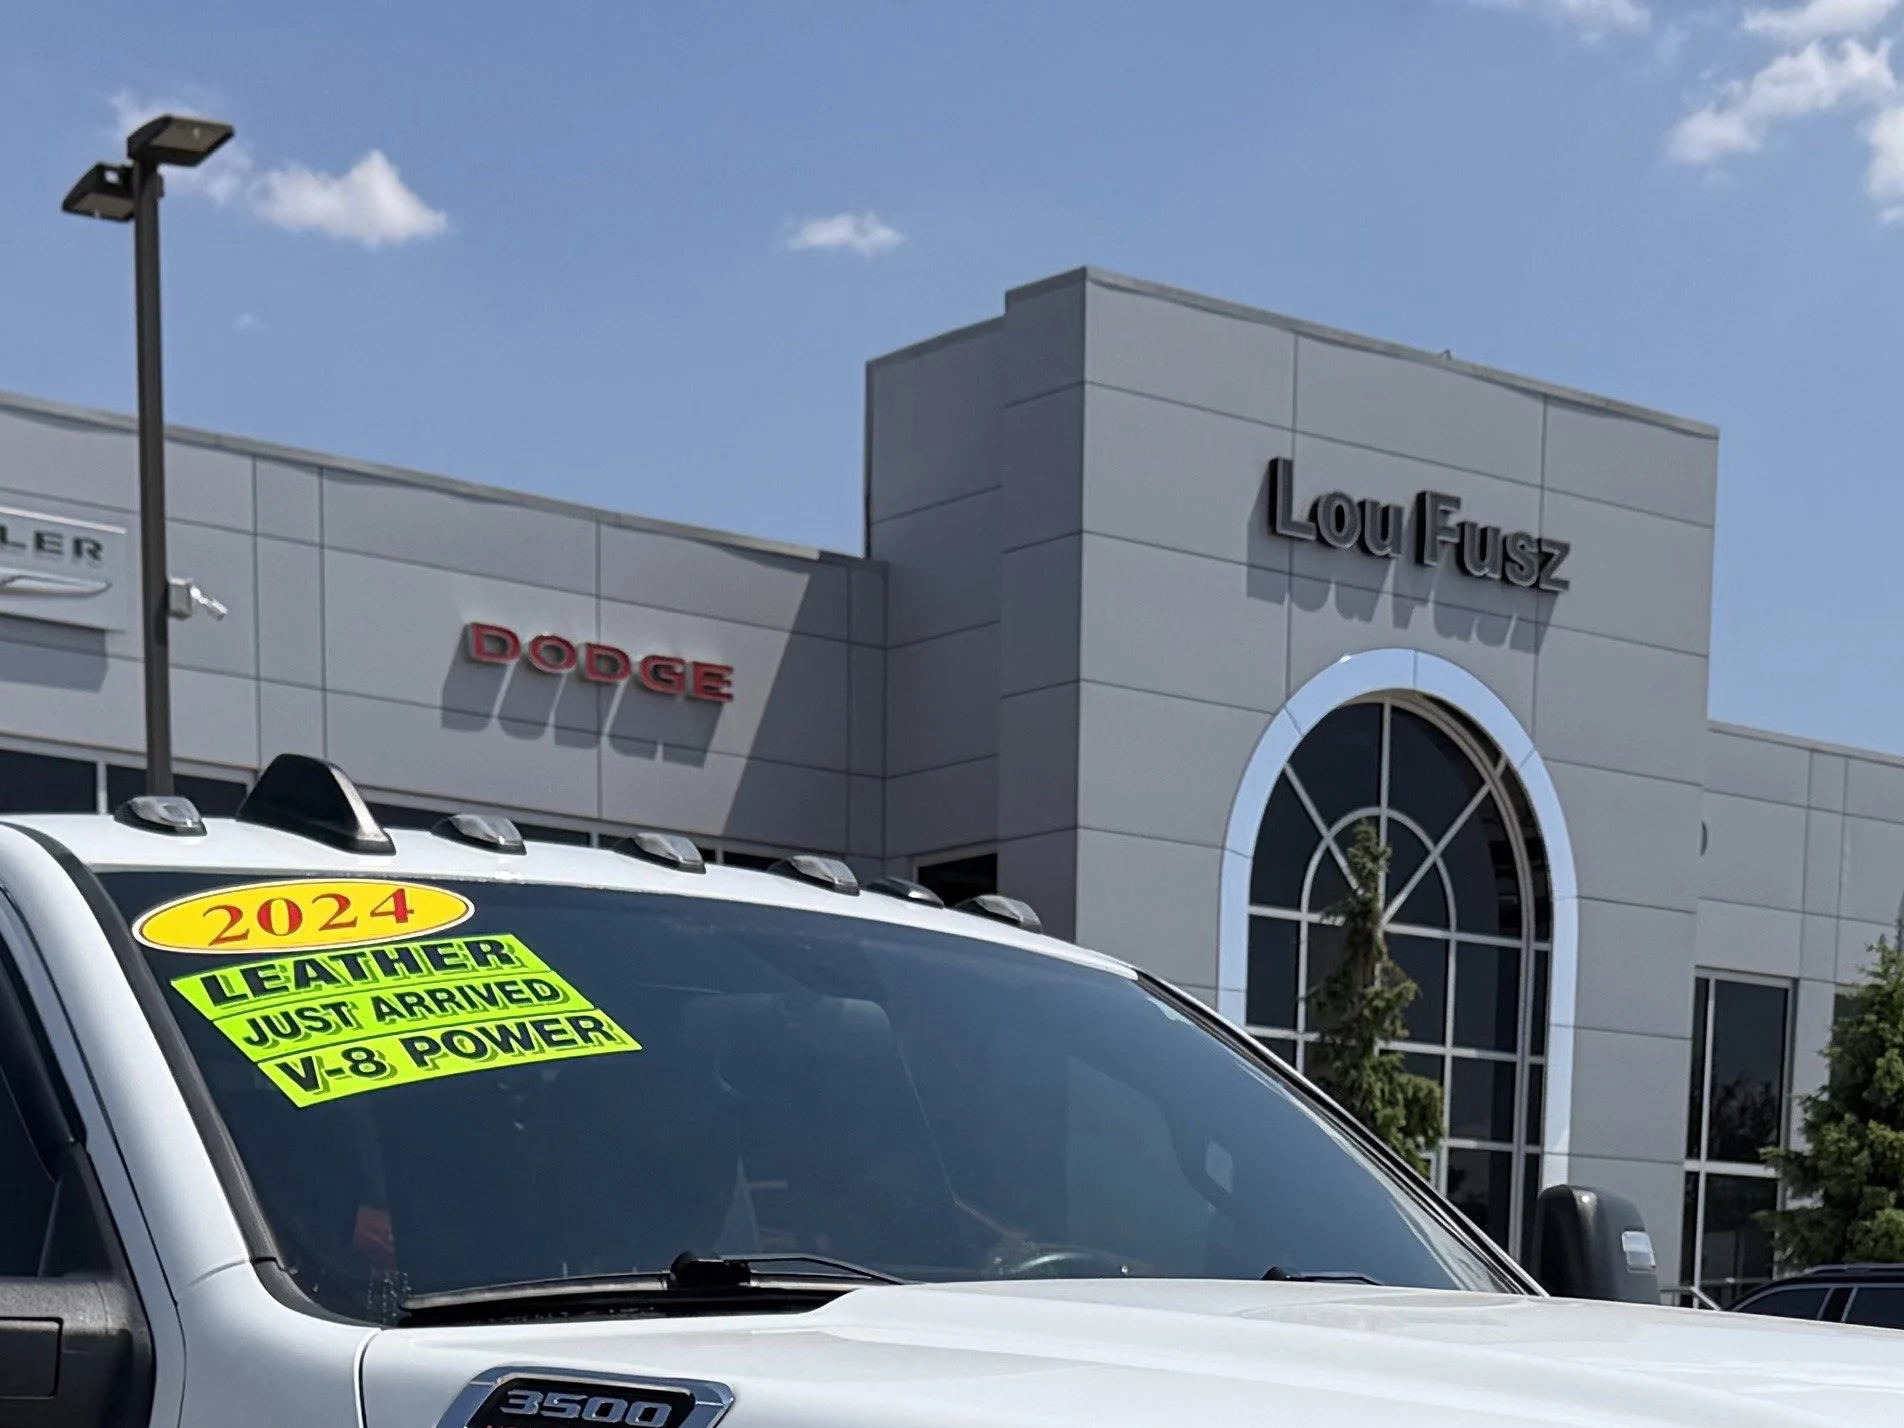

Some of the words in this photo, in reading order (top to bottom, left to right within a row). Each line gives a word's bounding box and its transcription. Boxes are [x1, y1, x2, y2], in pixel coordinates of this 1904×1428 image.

[1268, 456, 1404, 558] Lou
[1415, 490, 1571, 592] Fusz
[465, 620, 734, 703] DODGE
[202, 887, 415, 947] 2024
[200, 938, 520, 1007] LEATHER
[242, 1003, 357, 1048] JUST
[371, 977, 568, 1026] ARRIVED
[276, 1045, 392, 1094] V-8
[399, 1013, 621, 1071] POWER
[499, 1389, 673, 1428] 3500
